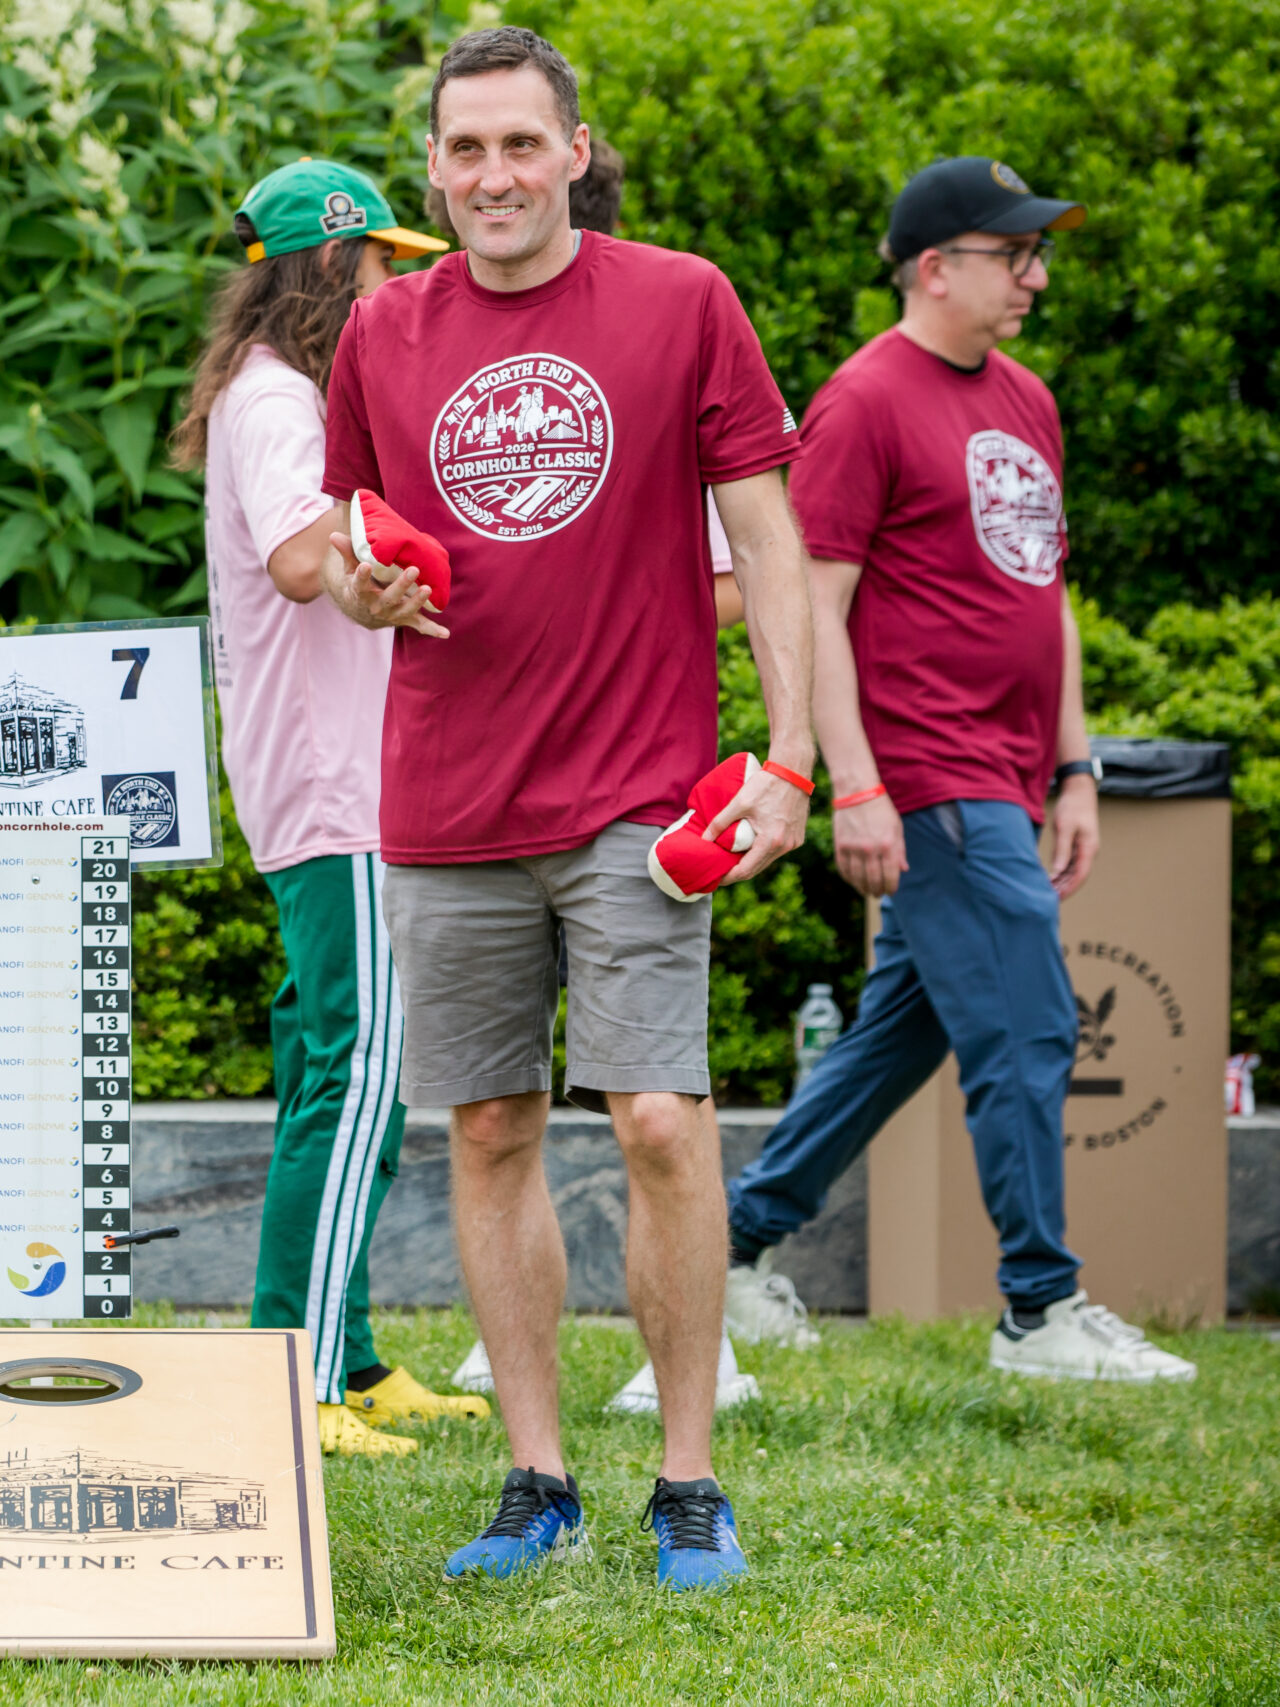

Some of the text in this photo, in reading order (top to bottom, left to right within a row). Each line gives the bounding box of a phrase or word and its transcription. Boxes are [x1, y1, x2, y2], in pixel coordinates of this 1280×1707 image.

[473, 361, 573, 394] NORTH END
[505, 442, 535, 455] 2026
[442, 451, 601, 482] CORNHOLE CLASSIC
[498, 523, 544, 536] EST. 2016
[112, 647, 150, 700] 7
[120, 779, 159, 792] NORTH END
[51, 797, 96, 816] CAFE
[146, 813, 173, 822] CLASSIC
[93, 840, 114, 855] 21
[92, 862, 117, 878] 20
[94, 884, 118, 900] 19
[93, 906, 117, 922] 18
[94, 928, 118, 943] 17
[93, 950, 117, 965] 16
[95, 972, 118, 987] 15
[1079, 941, 1185, 1038] RECREATION
[94, 993, 119, 1009] 14
[95, 1016, 119, 1031] 13
[95, 1036, 119, 1052] 12
[96, 1059, 117, 1074] 11
[95, 1080, 120, 1096] 10
[101, 1103, 113, 1118] 9
[1084, 1097, 1167, 1150] BOSTON
[101, 1124, 113, 1140] 8
[101, 1147, 113, 1162] 7
[101, 1168, 114, 1184] 6
[102, 1190, 113, 1206] 5
[101, 1212, 114, 1227] 4
[100, 1255, 113, 1271] 2
[103, 1278, 112, 1293] 1
[100, 1299, 114, 1315] 0
[160, 1555, 284, 1570] CAFE
